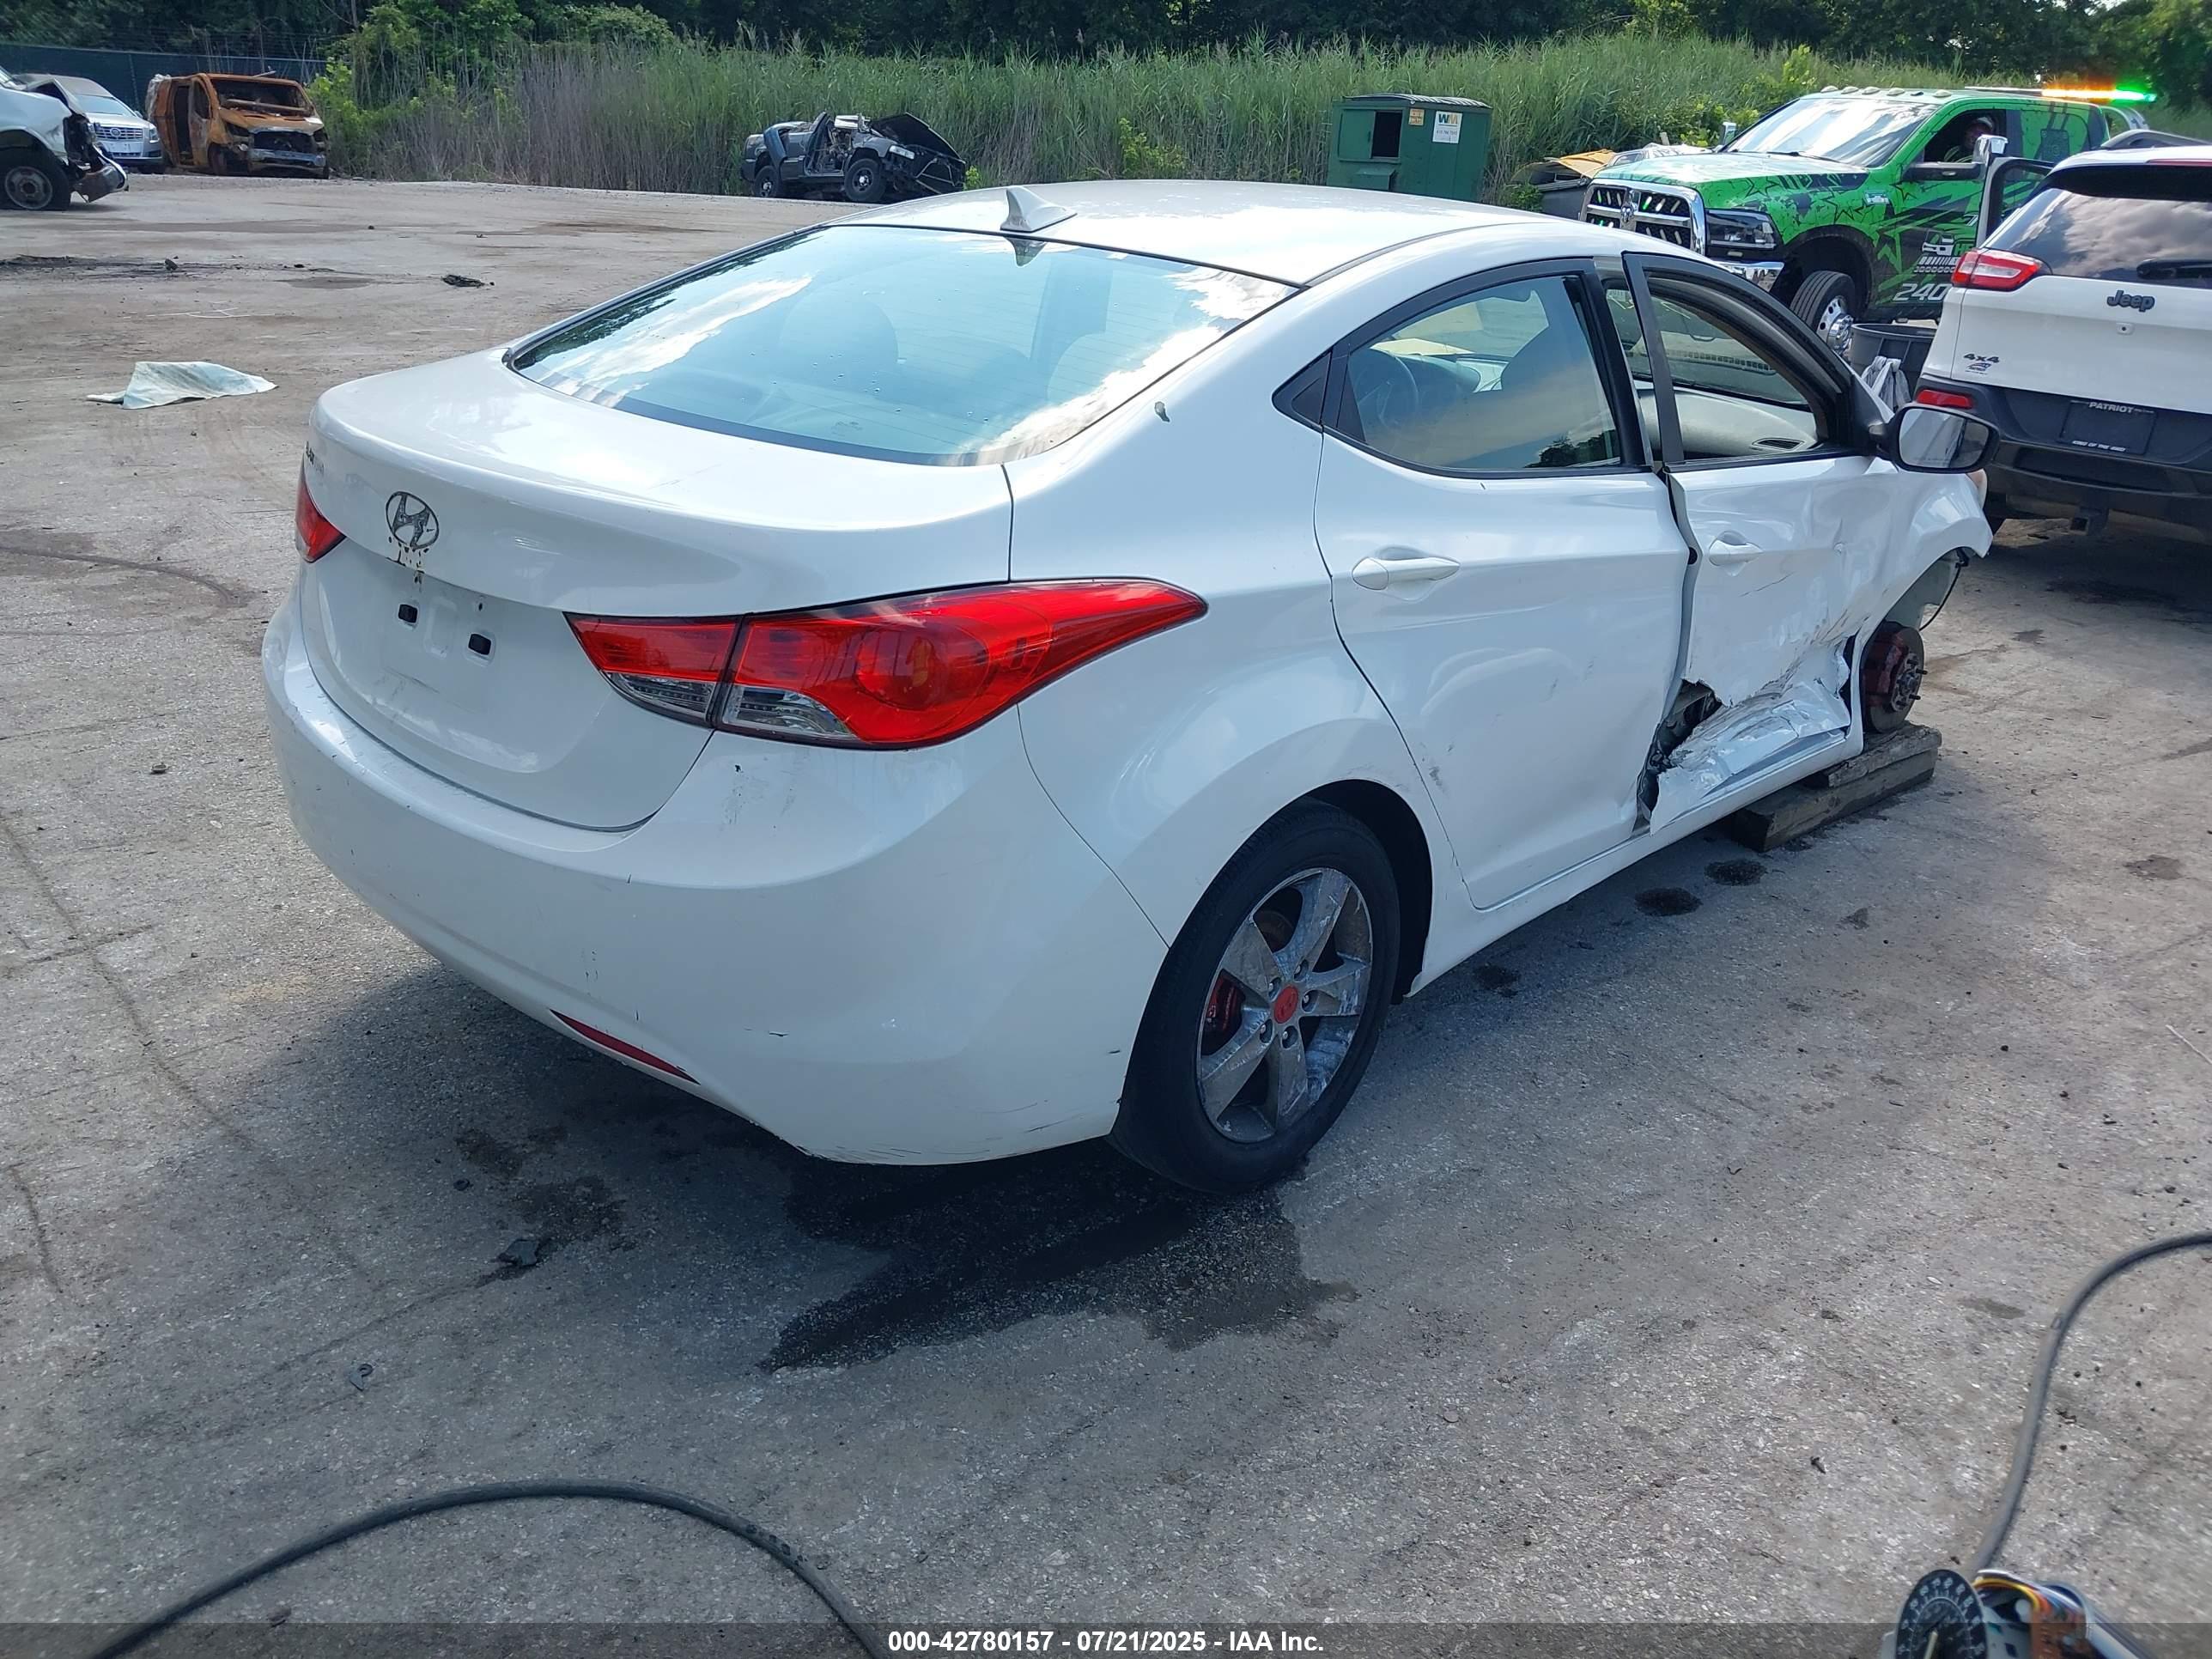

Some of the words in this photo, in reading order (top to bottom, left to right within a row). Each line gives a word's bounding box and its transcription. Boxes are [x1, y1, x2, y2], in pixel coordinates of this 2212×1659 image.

[1438, 113, 1458, 125] WM
[2106, 289, 2155, 313] Jeep
[1964, 353, 2000, 363] 4x4
[2088, 401, 2134, 413] PATRIOT
